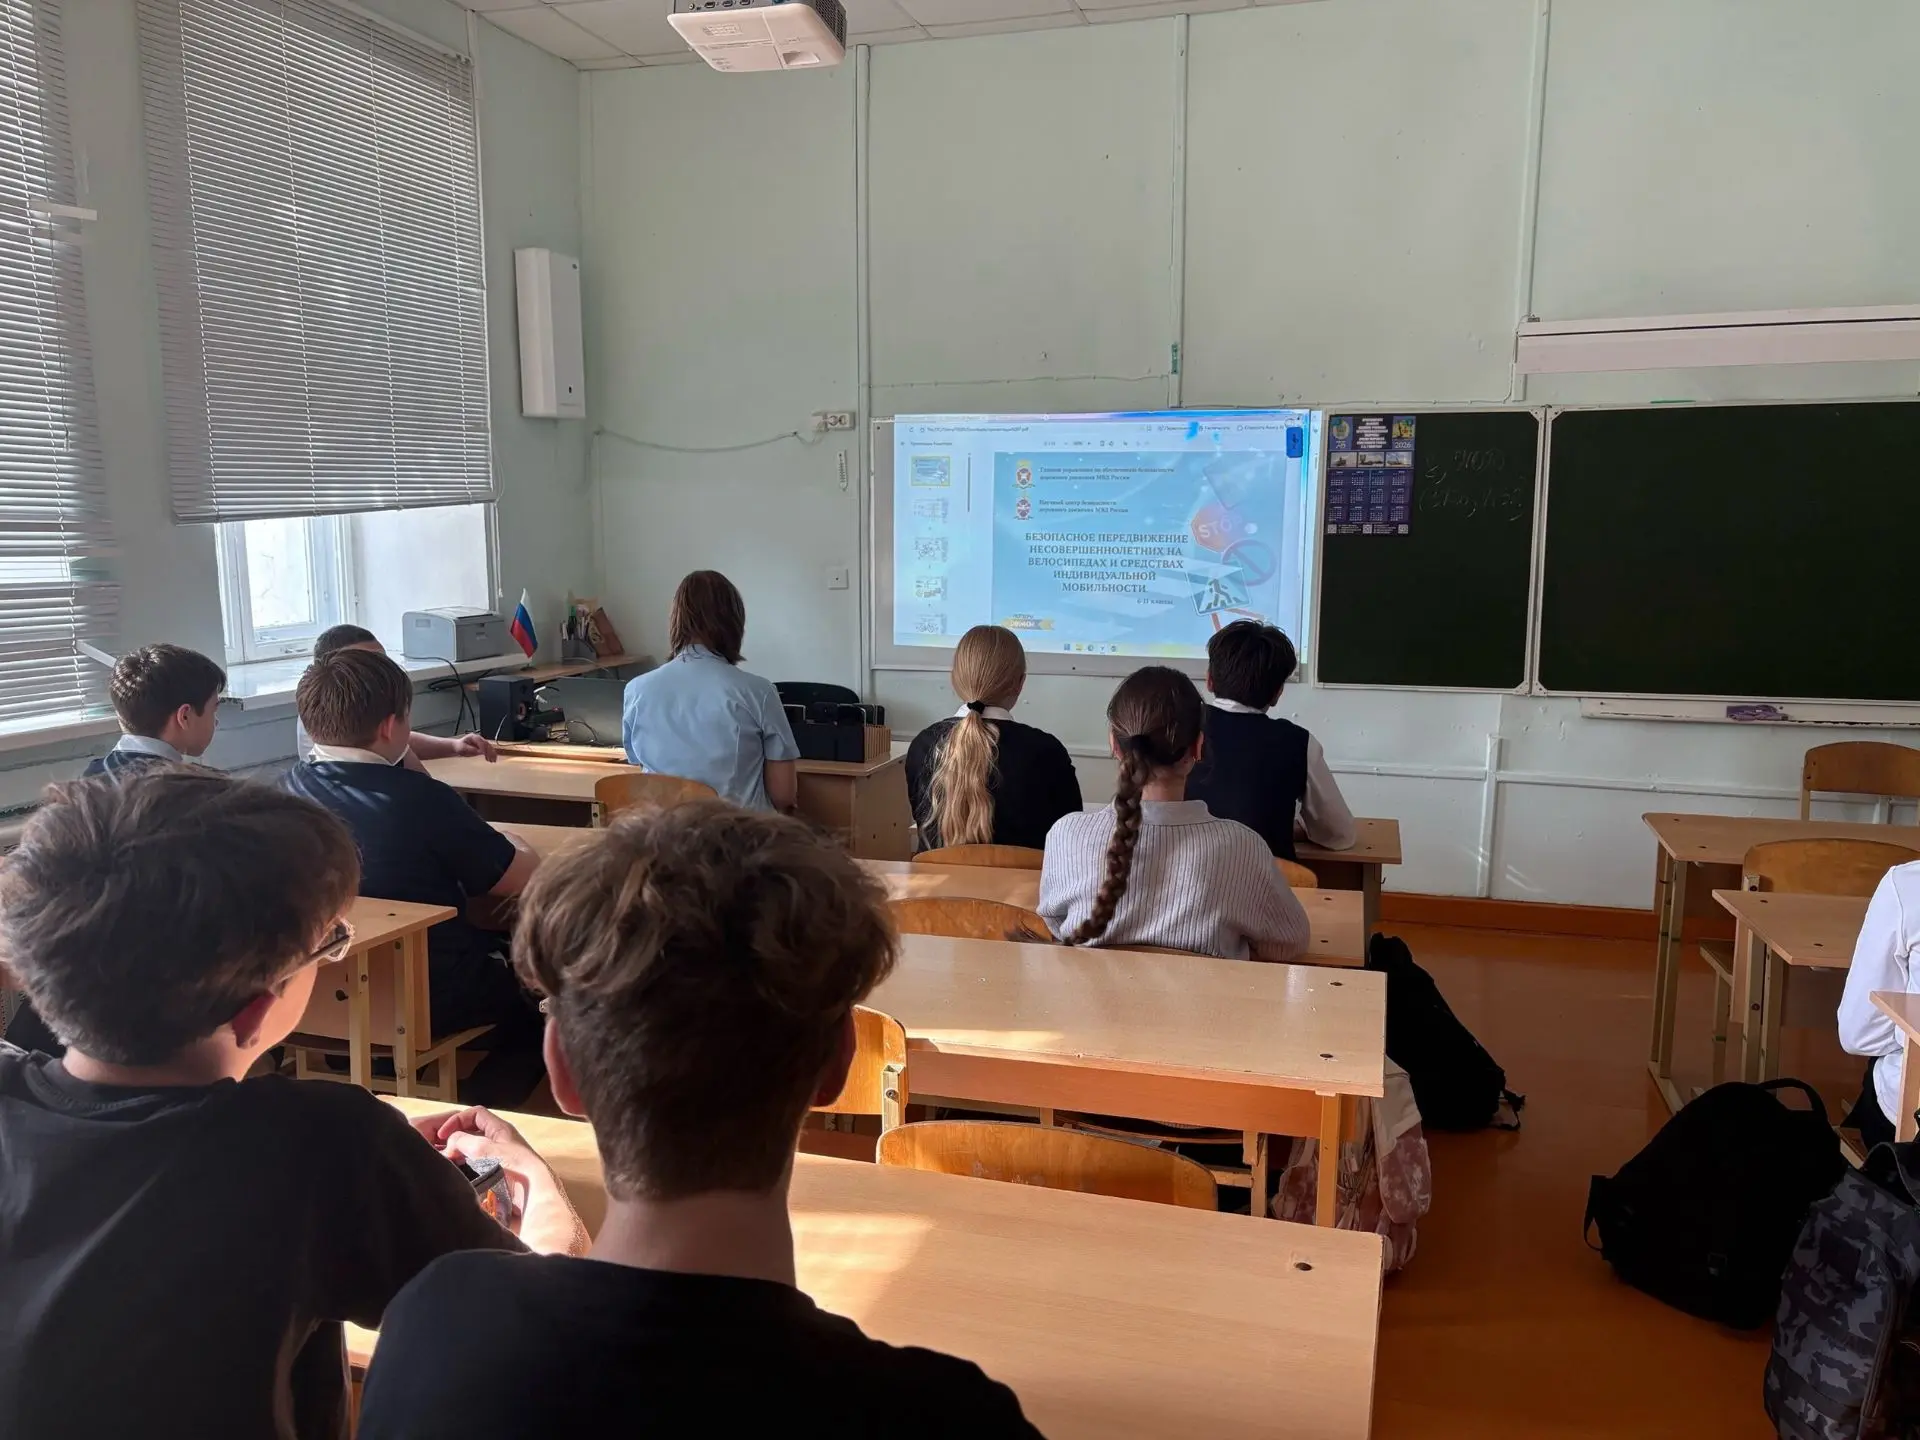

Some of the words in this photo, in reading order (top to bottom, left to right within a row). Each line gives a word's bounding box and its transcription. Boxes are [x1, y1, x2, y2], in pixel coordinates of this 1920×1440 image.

[1395, 441, 1412, 449] 2026
[1025, 532, 1096, 542] БЕЗОПАСНОЕ
[1098, 533, 1189, 544] ПЕРЕДВИЖЕНИЕ
[1030, 545, 1165, 556] НЕСОВЕРШЕННОЛЕТНИХ
[1166, 547, 1183, 556] НА
[1028, 558, 1107, 568] ВЕЛОСИПЕДАХ
[1110, 559, 1118, 568] И
[1120, 559, 1184, 569] СРЕДСТВАХ
[1053, 570, 1157, 581] ИНДИВИДУАЛЬНОЙ
